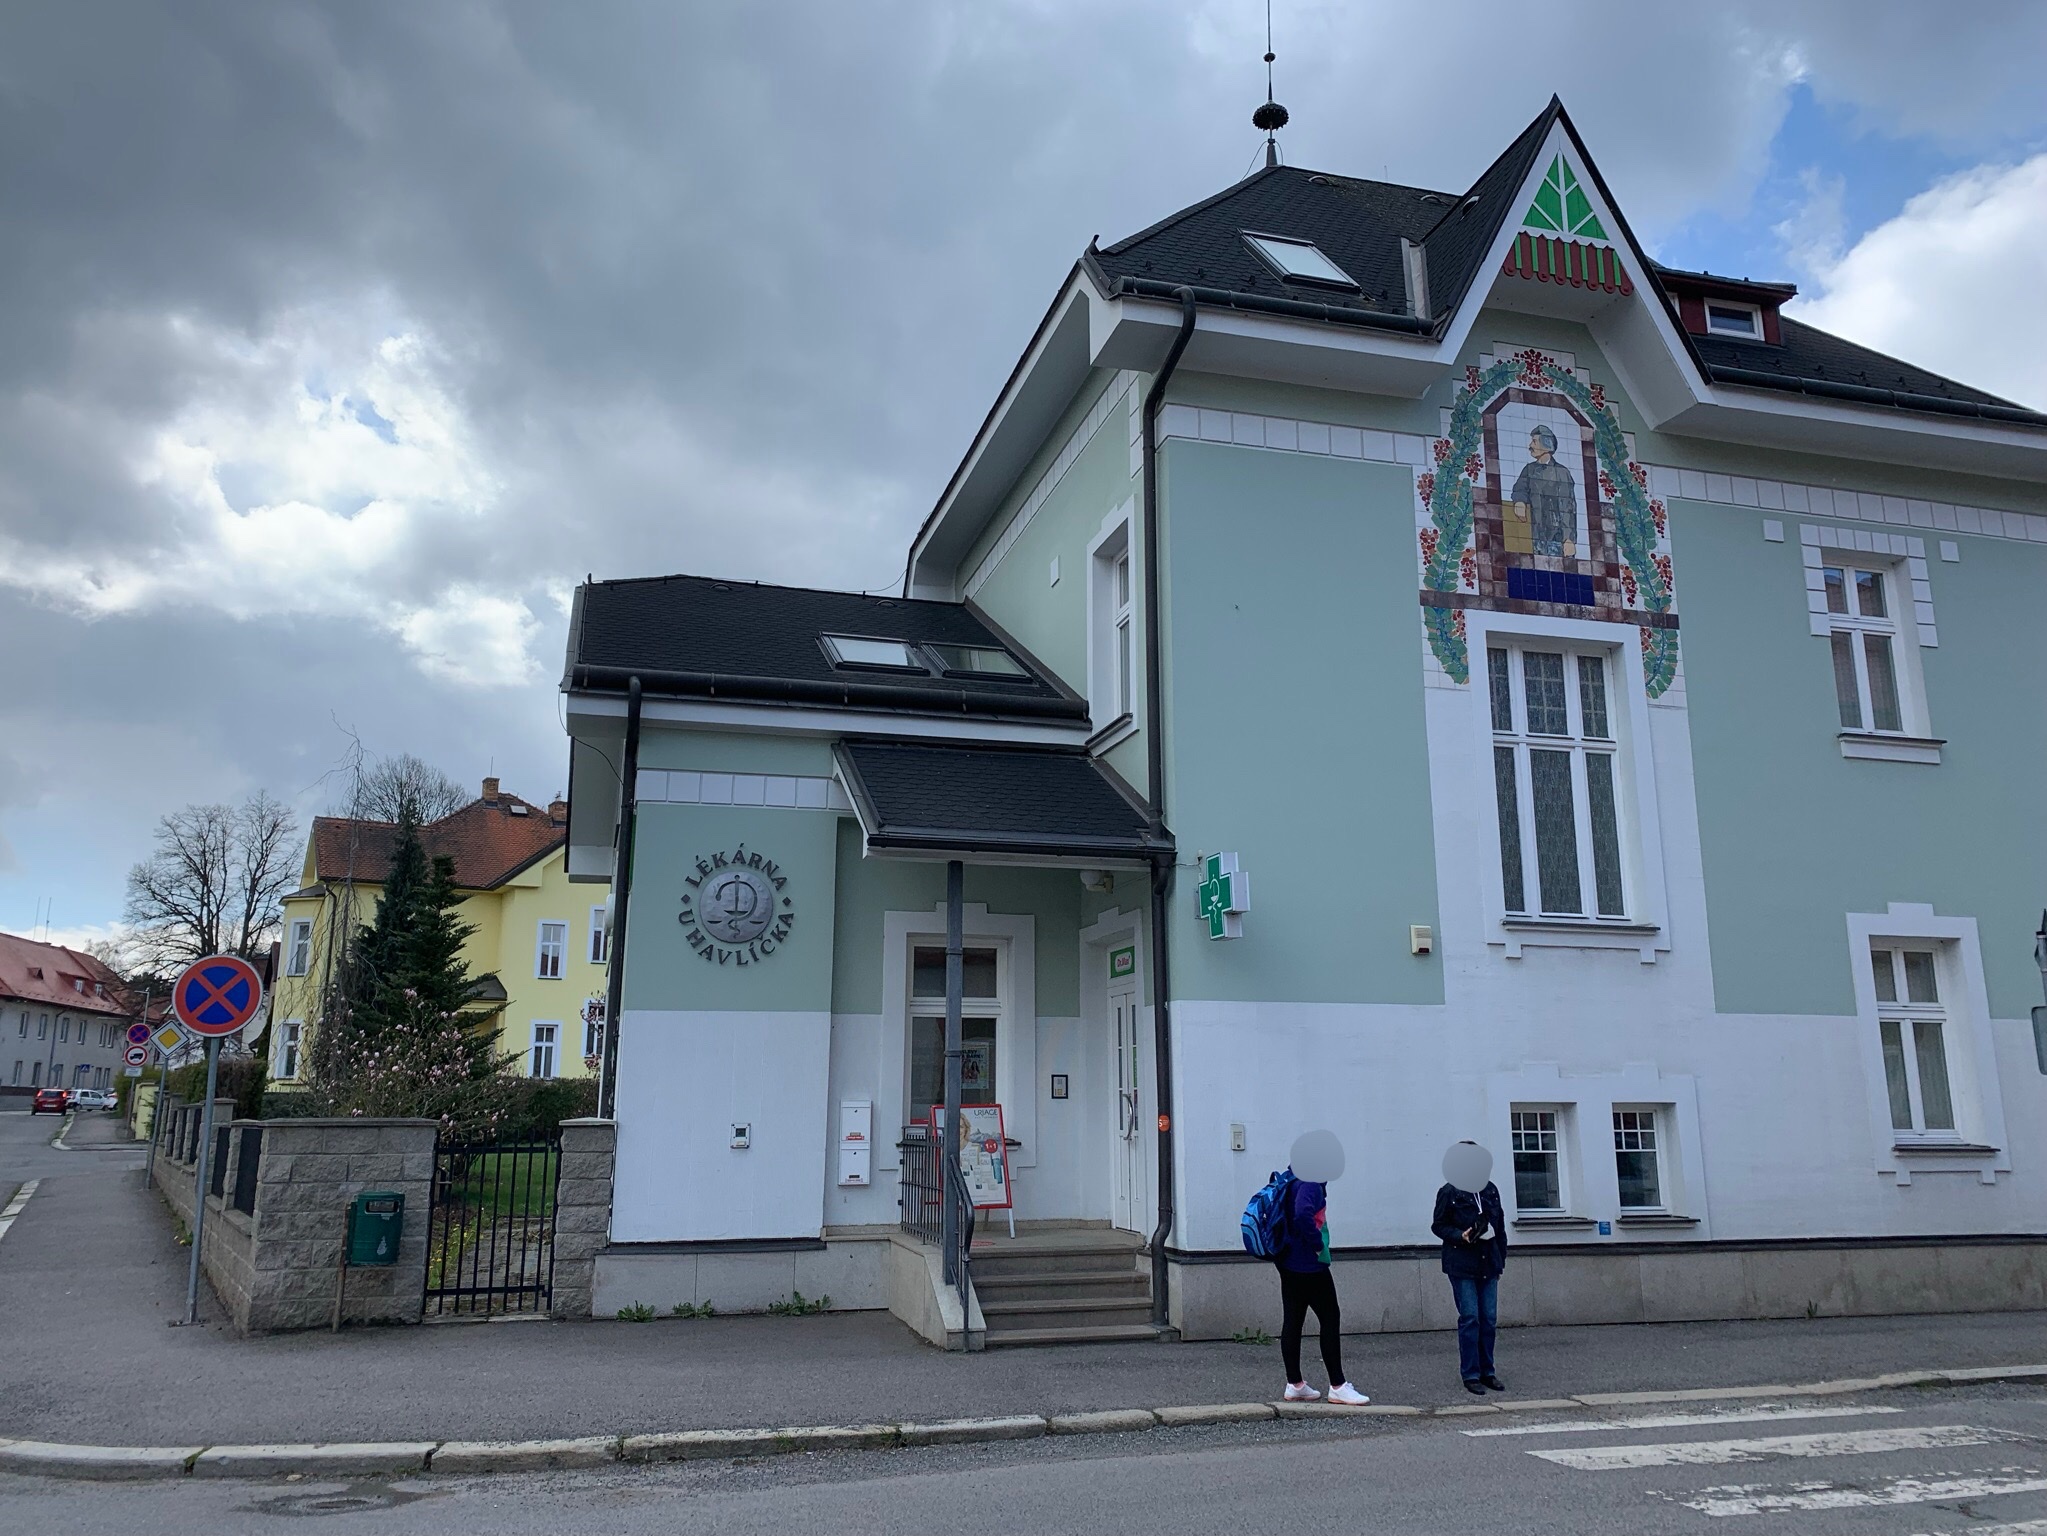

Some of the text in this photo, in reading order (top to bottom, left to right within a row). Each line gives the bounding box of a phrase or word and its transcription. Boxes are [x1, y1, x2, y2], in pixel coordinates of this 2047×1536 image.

[685, 843, 787, 891] LÉKÁRNA
[678, 909, 794, 966] U HAVLÍČKA
